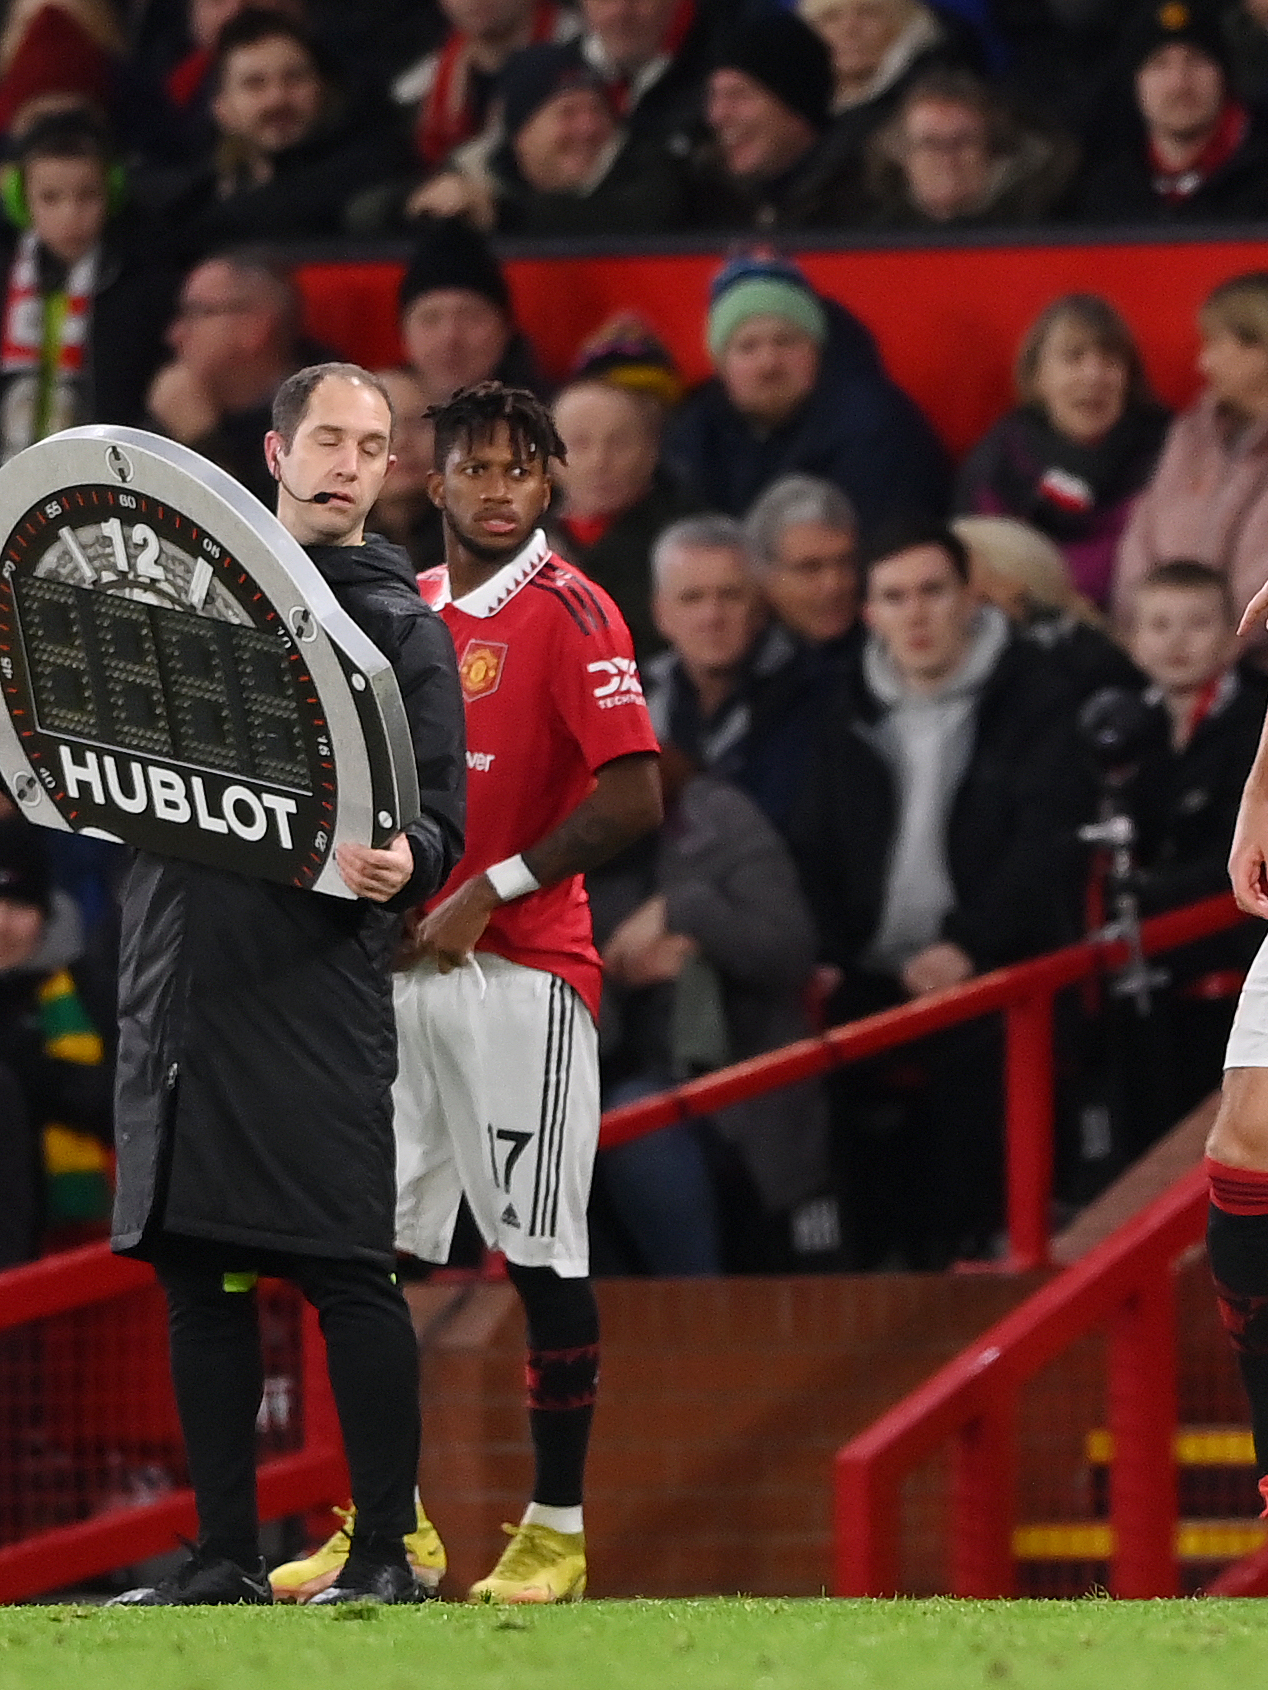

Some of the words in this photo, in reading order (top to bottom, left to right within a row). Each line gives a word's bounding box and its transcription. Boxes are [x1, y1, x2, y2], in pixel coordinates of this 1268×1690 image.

[44, 500, 63, 519] 55
[118, 494, 137, 509] 60
[100, 517, 166, 580] 12
[59, 745, 298, 850] HUBLOT
[314, 830, 328, 852] 20
[487, 1123, 535, 1195] 17
